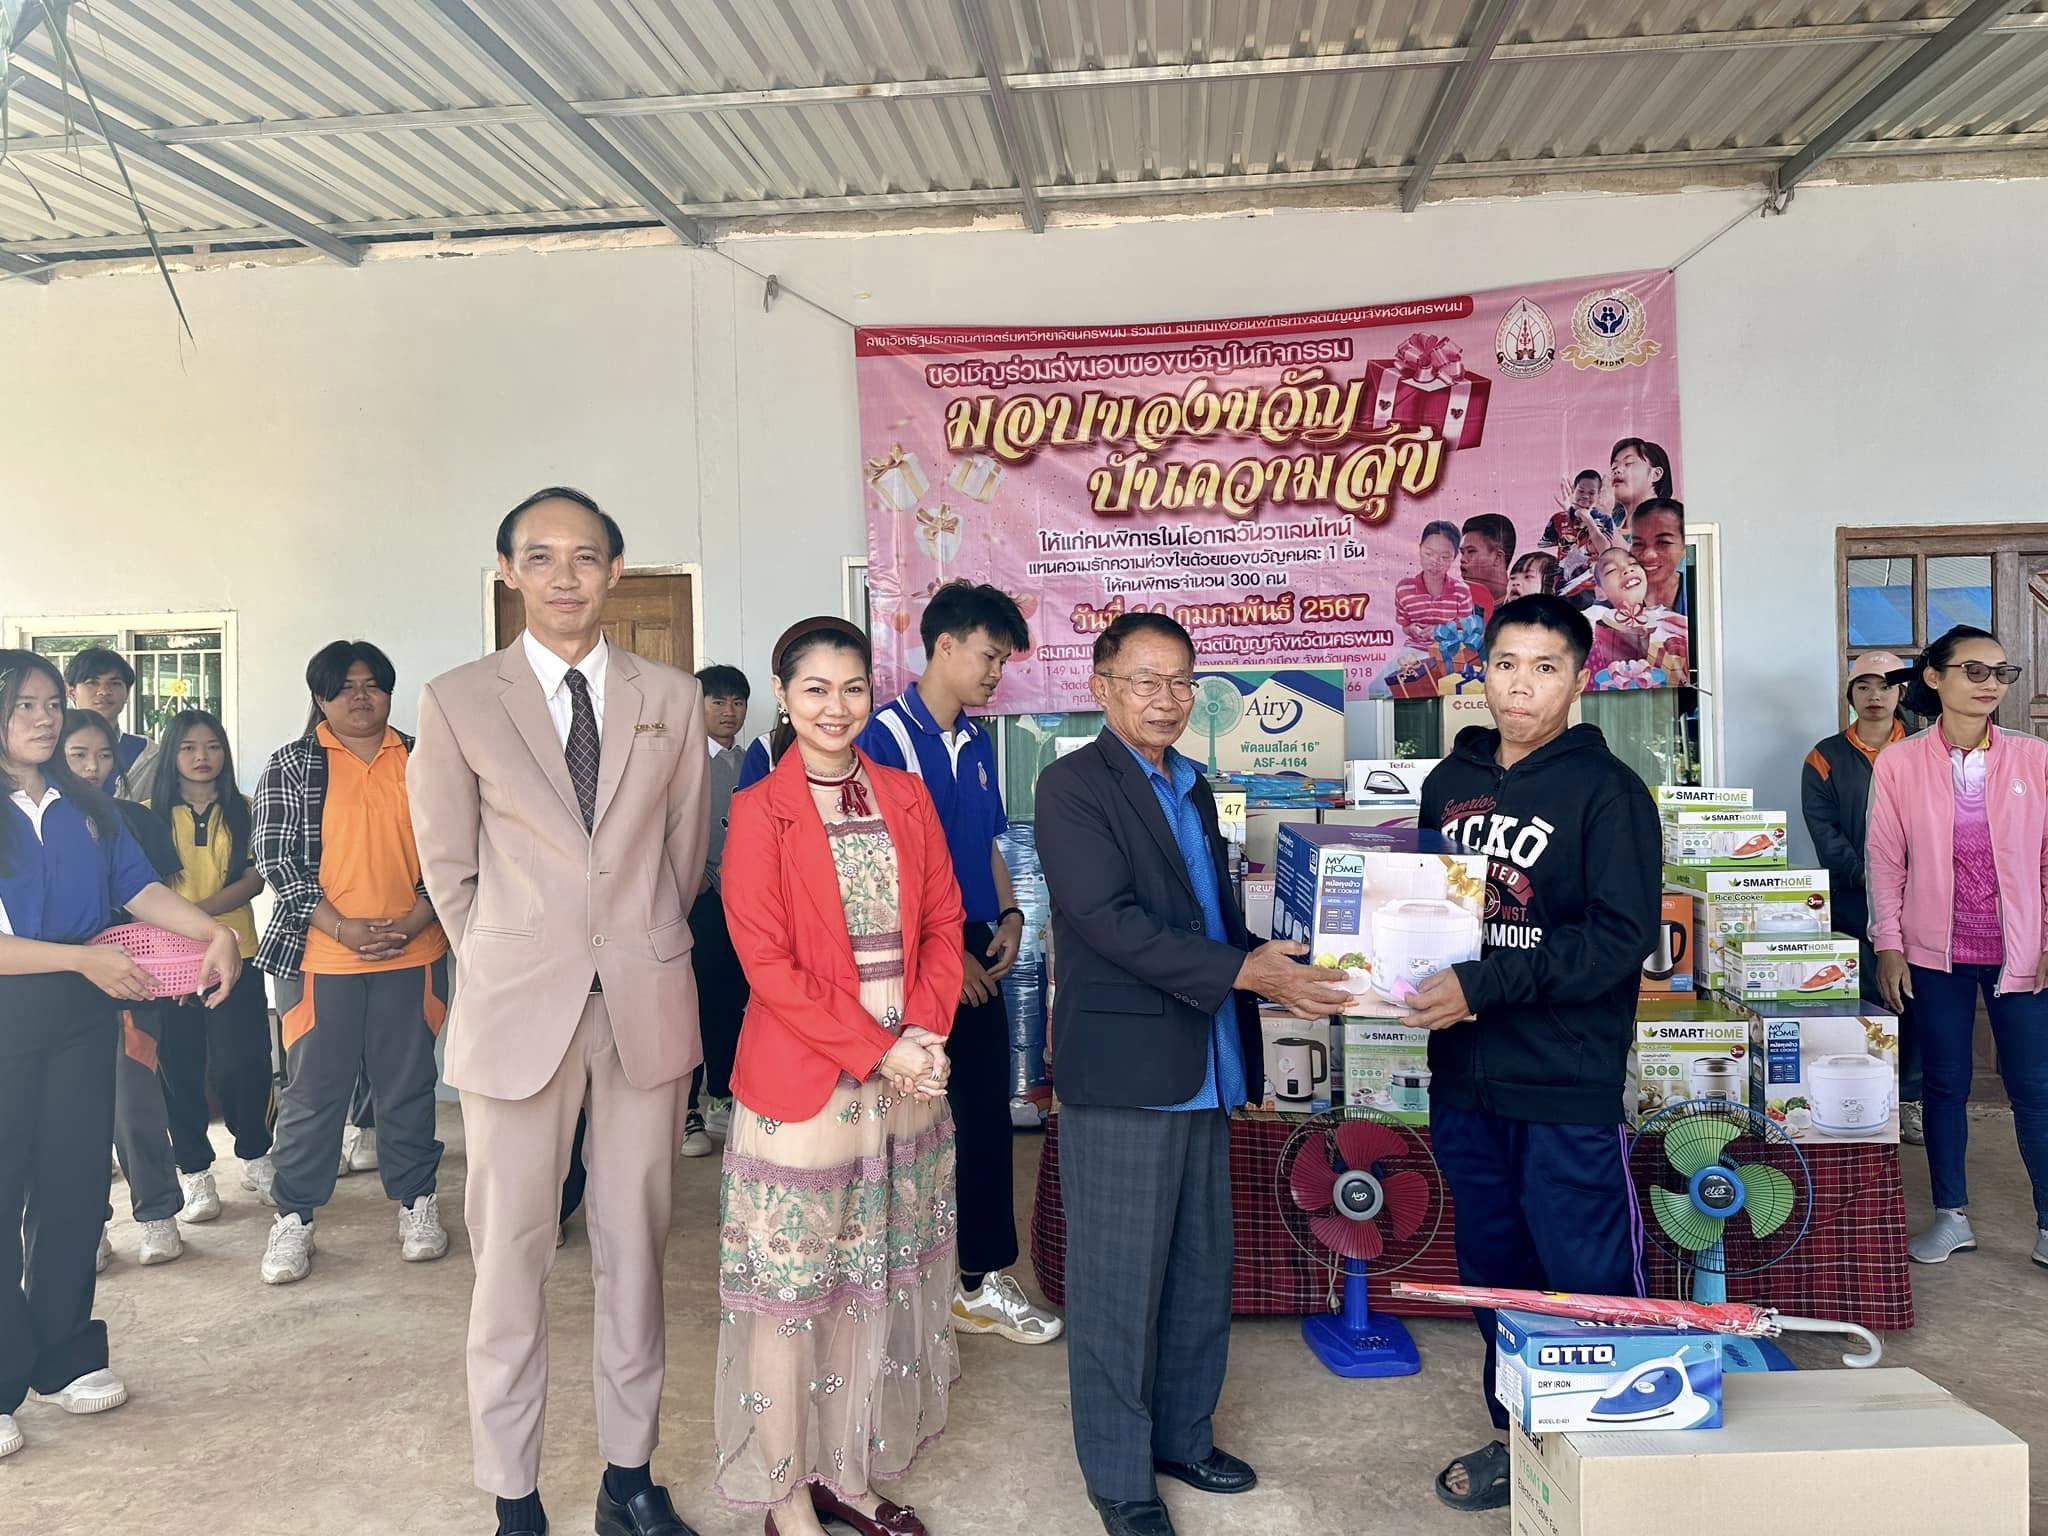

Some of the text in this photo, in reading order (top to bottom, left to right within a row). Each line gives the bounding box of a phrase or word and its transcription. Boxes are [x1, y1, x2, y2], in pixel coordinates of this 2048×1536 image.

[927, 339, 1351, 386] ขอเชิญร่วมส่งมอบของขวัญในกิจกรรม
[946, 367, 1367, 461] มอบของขวัญ
[1088, 425, 1445, 525] ปันความสุข
[1038, 516, 1353, 552] ให้แก่คนพิการในโอกาสวันวาเลนไทน์
[1329, 545, 1336, 560] 1
[1343, 540, 1365, 559] ชิ้น
[1105, 572, 1287, 593] ให้คนพิการจำนวน 300 คน
[1302, 596, 1368, 620] 2567
[1245, 695, 1292, 721] Airy
[1240, 740, 1298, 753] พัดลมสไลด์
[1253, 757, 1308, 769] ASF-4164
[1675, 791, 1748, 802] SMARTHOME
[1224, 803, 1242, 816] 47
[1711, 813, 1764, 822] SMARTHOME
[1325, 854, 1346, 866] MY
[1325, 865, 1363, 875] HOME
[1743, 877, 1813, 888] SMARTHOME
[1715, 893, 1764, 902] Rice Cooker
[1481, 922, 1543, 949] AMOUS
[1777, 943, 1834, 952] SMARTHOME
[1768, 1022, 1785, 1031] MY
[1660, 1027, 1744, 1039] SMARTHOME
[1769, 1030, 1799, 1039] HOME
[1539, 1345, 1615, 1366] OTTO
[1538, 1380, 1571, 1389] DRY IRON
